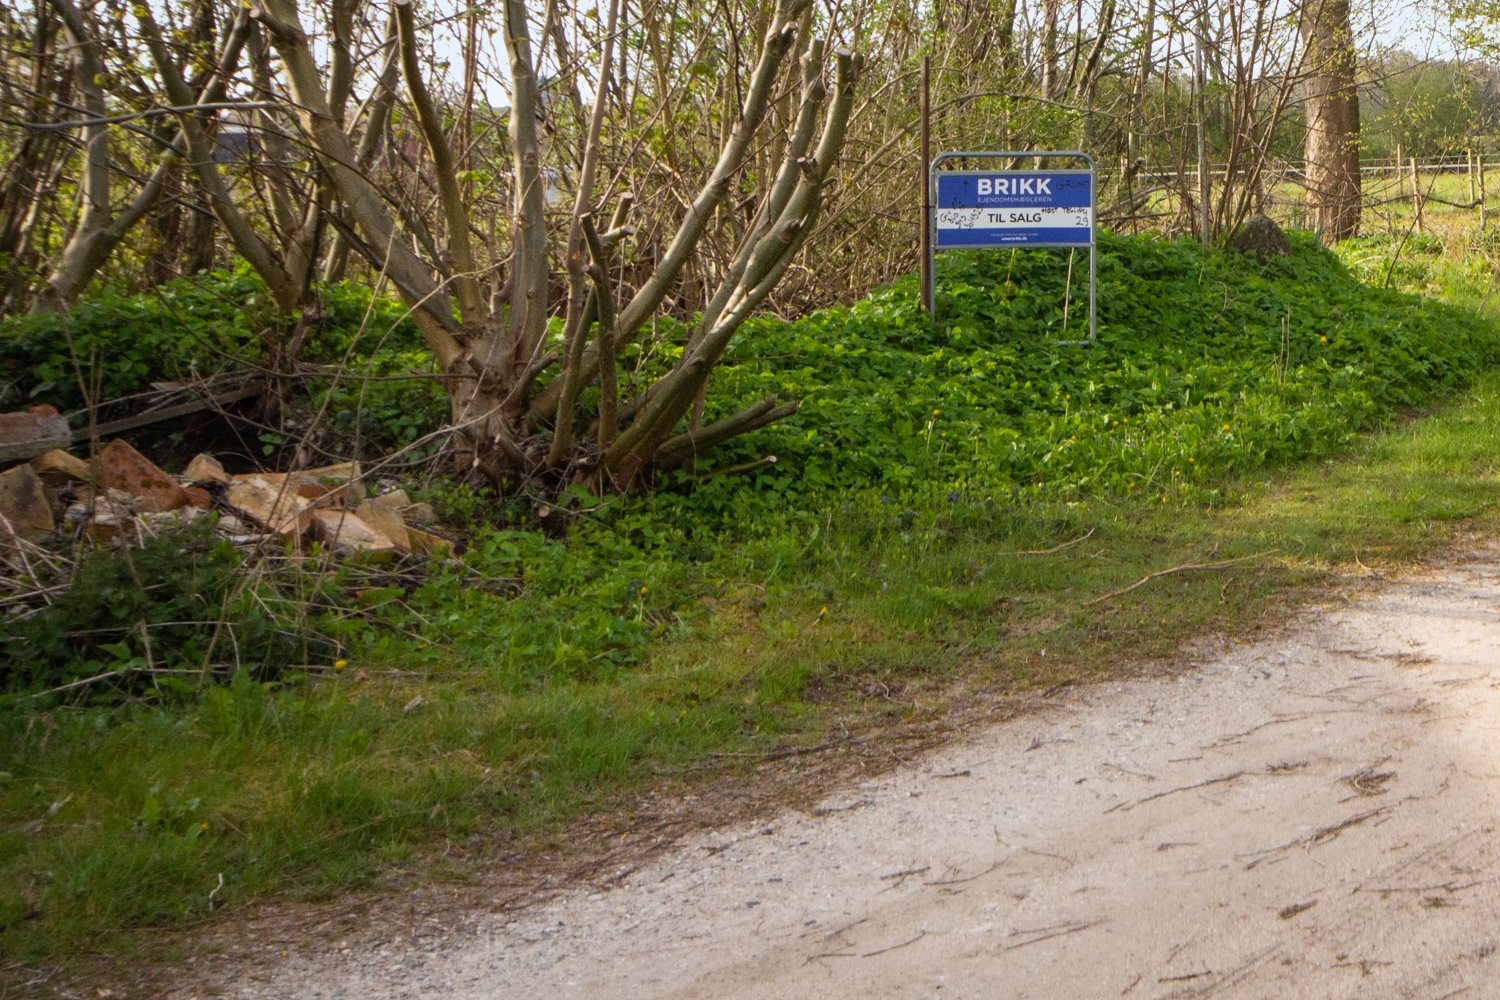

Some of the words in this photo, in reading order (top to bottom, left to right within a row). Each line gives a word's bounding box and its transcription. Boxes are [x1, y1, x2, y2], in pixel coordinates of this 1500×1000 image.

[977, 178, 1052, 195] BRIKK
[987, 213, 1006, 223] TIL
[1009, 213, 1042, 223] SALG
